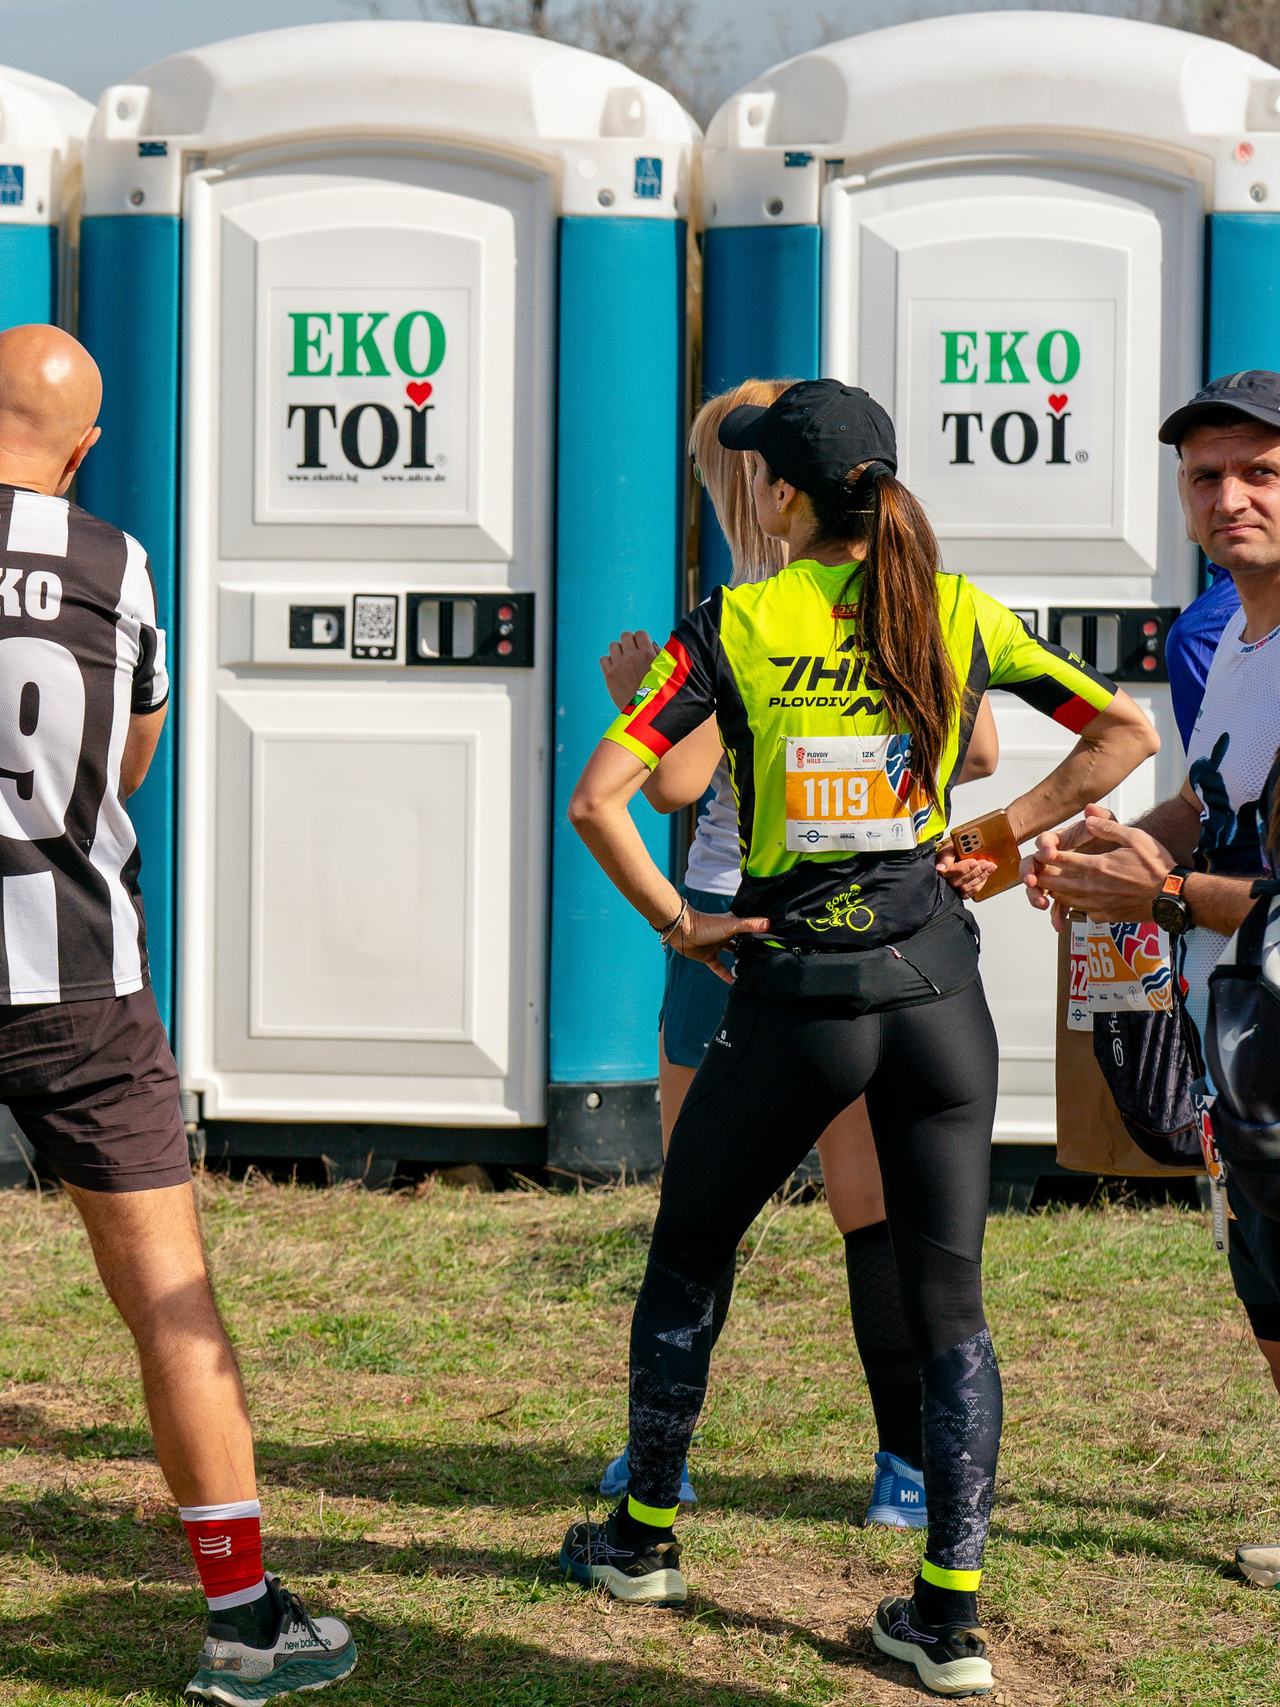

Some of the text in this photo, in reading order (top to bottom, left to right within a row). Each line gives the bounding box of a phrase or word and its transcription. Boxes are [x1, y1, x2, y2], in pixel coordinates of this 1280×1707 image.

[287, 310, 446, 377] EKO
[939, 329, 1081, 384] EKO
[287, 402, 435, 469] TOI
[941, 410, 1072, 465] TOI
[768, 697, 851, 708] PLOVDIV
[861, 750, 876, 759] 12K
[803, 777, 869, 817] 1119
[900, 1489, 919, 1504] HH
[284, 1641, 300, 1651] new
